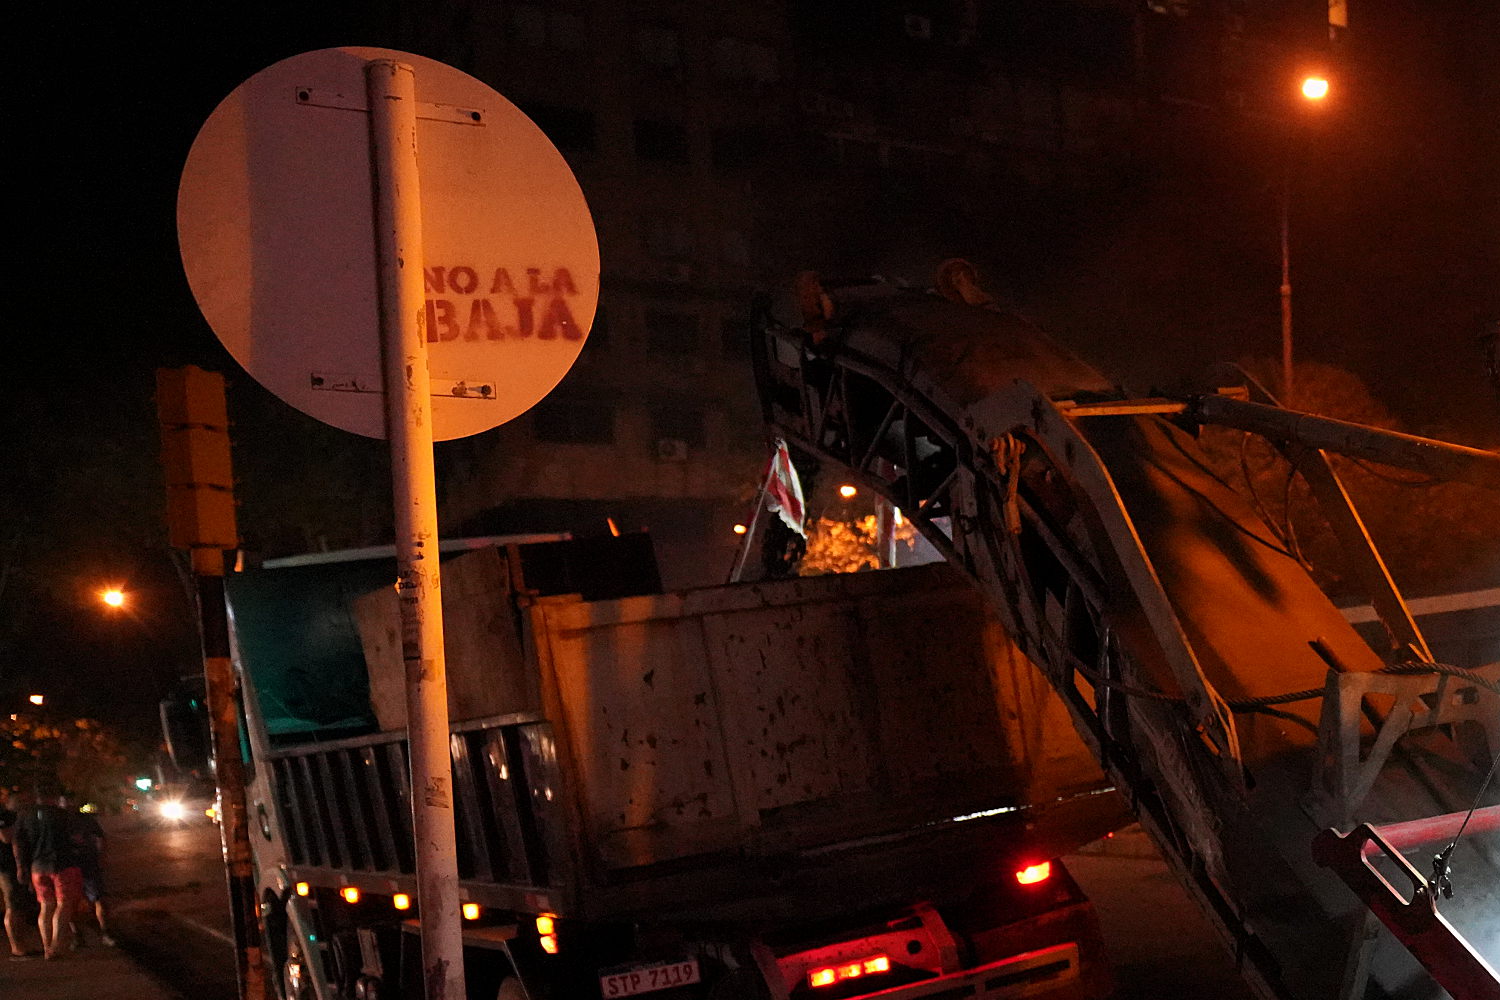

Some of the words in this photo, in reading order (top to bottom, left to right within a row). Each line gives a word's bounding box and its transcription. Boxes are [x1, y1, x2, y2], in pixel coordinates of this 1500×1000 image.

[424, 266, 479, 294] NO
[490, 267, 515, 294] A
[527, 267, 578, 295] LA
[426, 299, 583, 342] BAJA
[607, 973, 641, 996] STP
[649, 964, 693, 987] 7119
